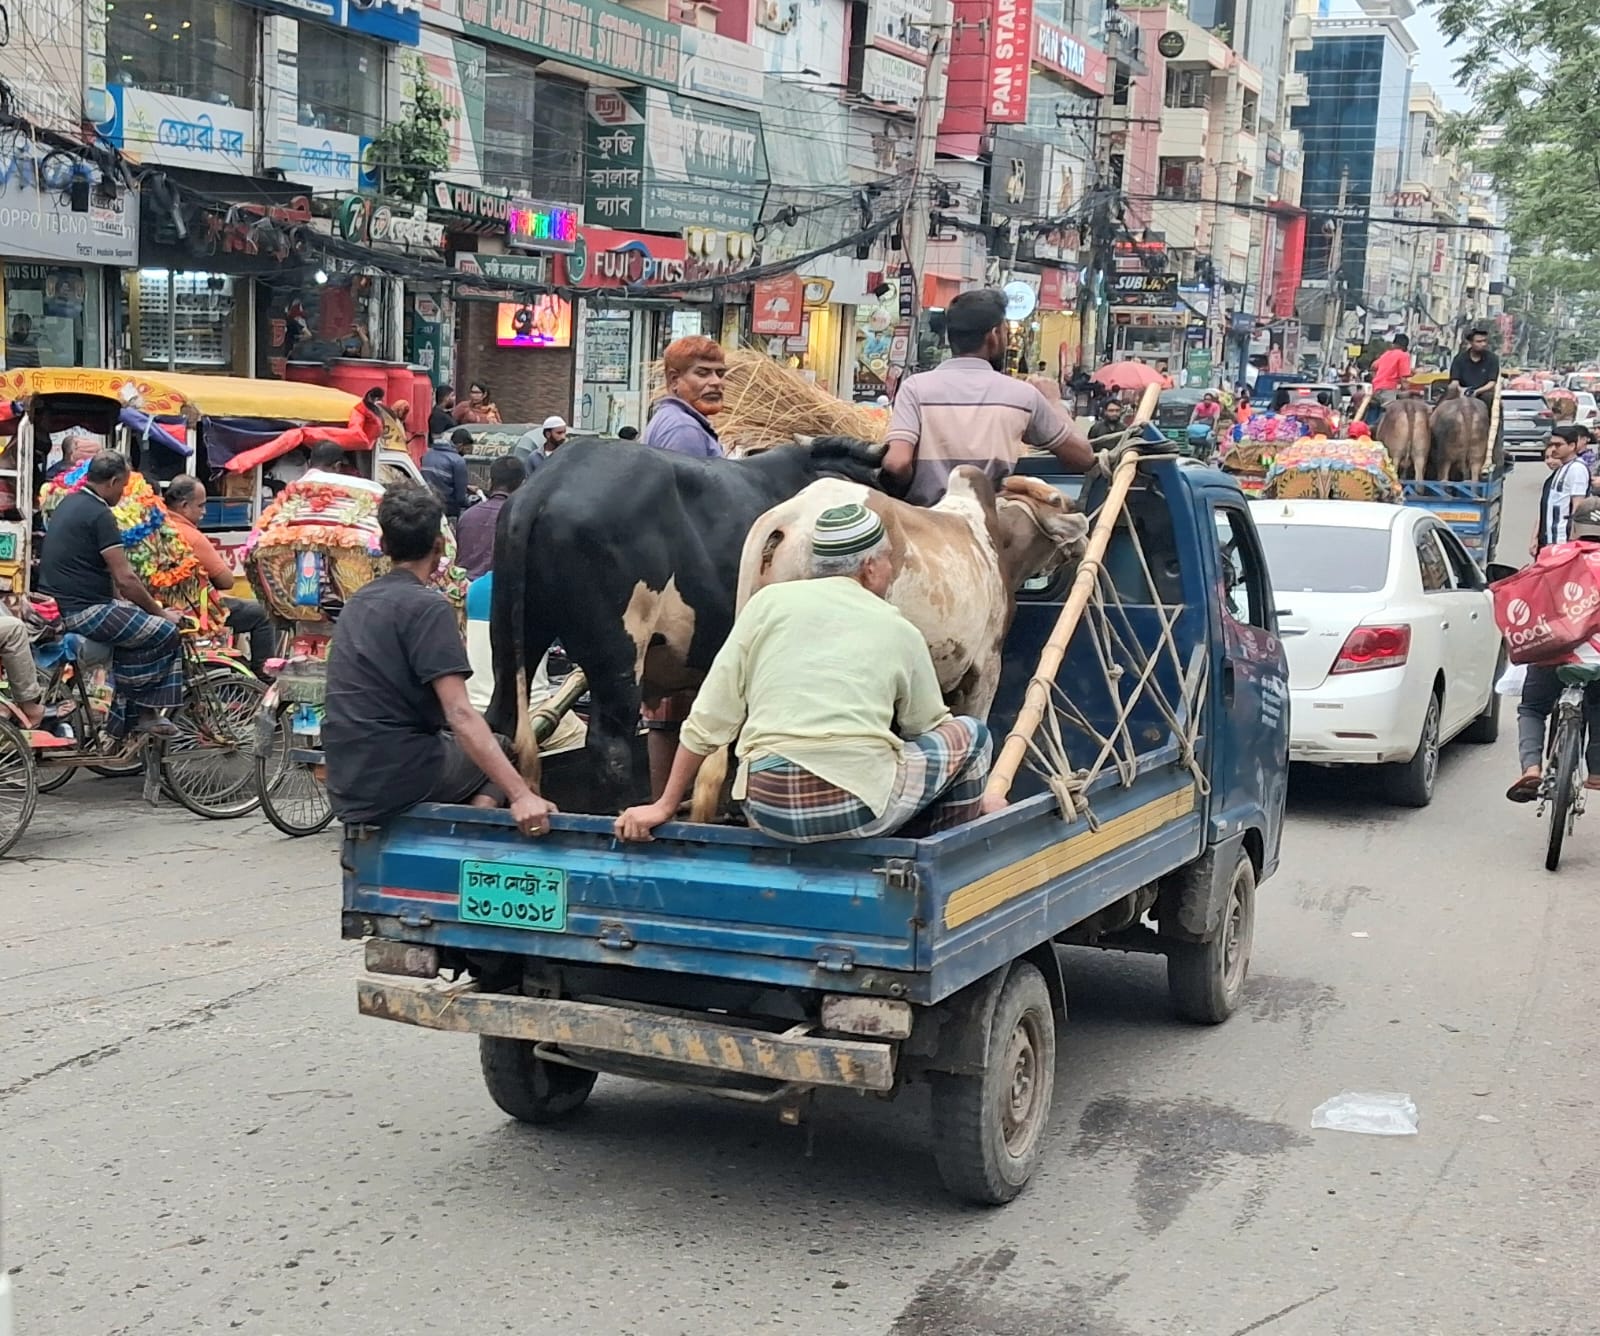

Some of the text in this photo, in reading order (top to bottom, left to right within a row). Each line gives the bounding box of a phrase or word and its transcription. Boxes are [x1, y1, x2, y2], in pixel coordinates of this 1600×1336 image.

[596, 11, 641, 74] STUDIO
[654, 29, 679, 83] LAB
[992, 0, 1018, 116] PAN STAR
[1038, 23, 1059, 63] PAN
[1060, 35, 1086, 76] STAR
[219, 129, 244, 159] ঘর
[597, 129, 636, 160] ফুজি
[699, 119, 732, 171] কালার
[589, 166, 641, 189] কালার
[455, 188, 478, 216] FUJI
[595, 195, 632, 217] ল্যাব
[1, 208, 40, 230] OPPO
[45, 212, 88, 235] TECNO
[594, 252, 628, 279] FUJI
[1505, 613, 1552, 647] foodi
[466, 870, 500, 888] ঢাকা
